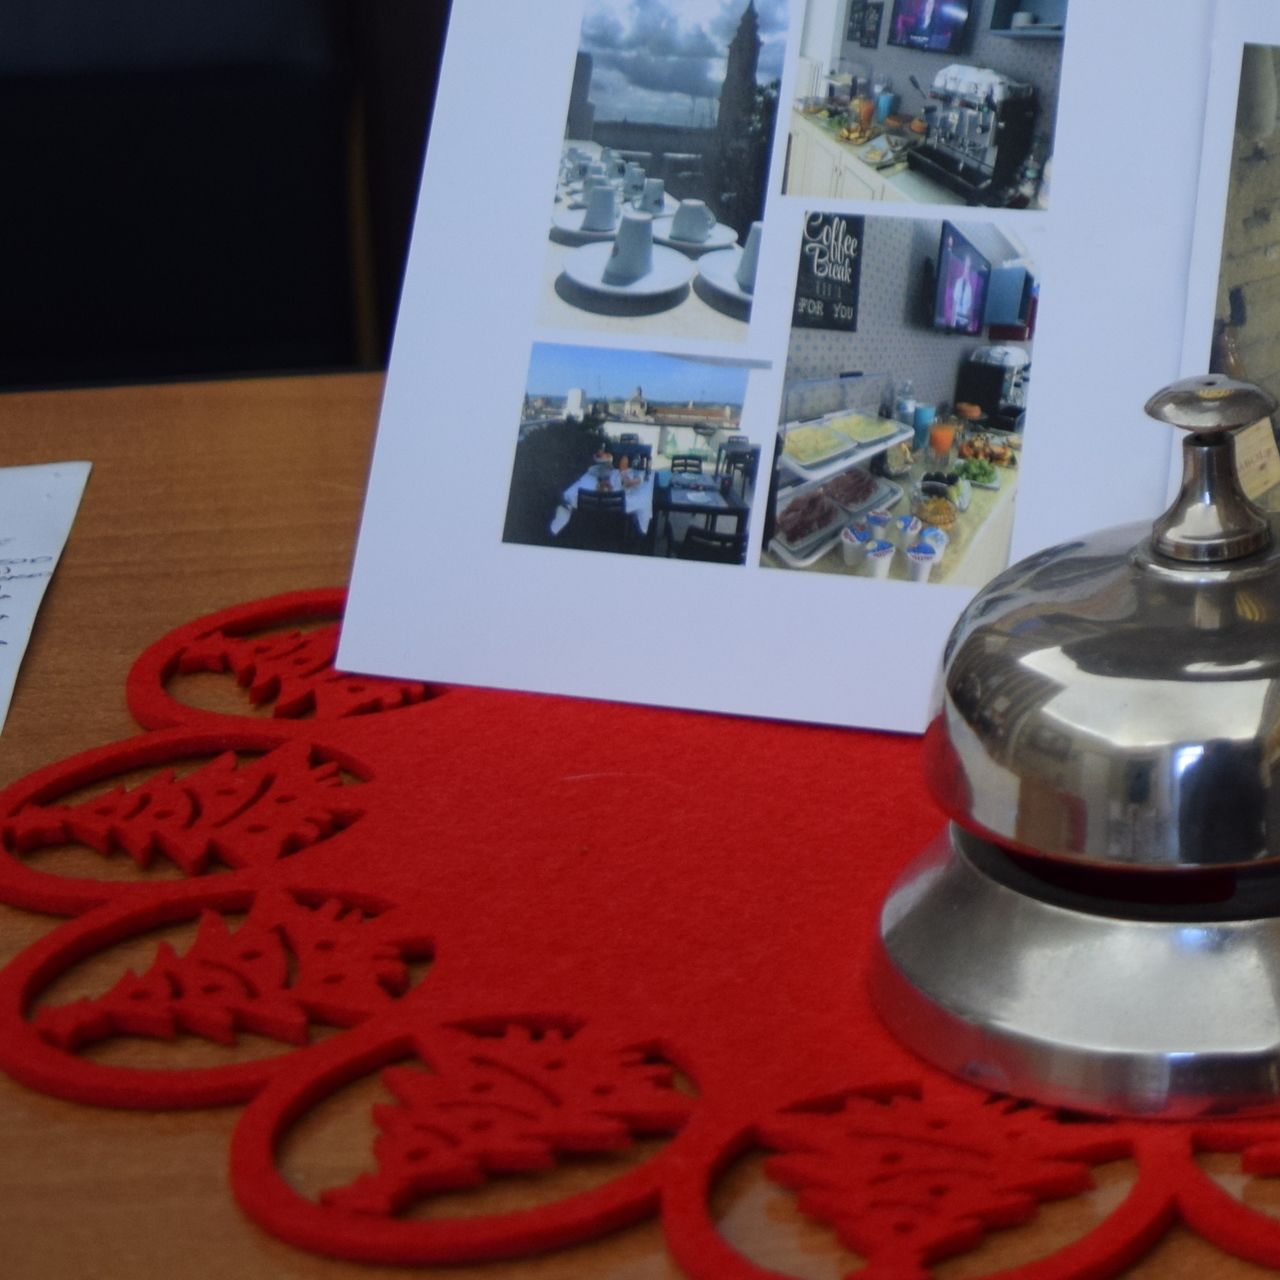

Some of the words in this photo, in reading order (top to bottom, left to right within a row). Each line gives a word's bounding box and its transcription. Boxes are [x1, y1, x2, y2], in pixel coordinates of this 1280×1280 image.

[804, 211, 858, 264] Coffee
[805, 242, 852, 282] Break
[798, 297, 825, 317] FOR
[833, 302, 854, 320] YOU
